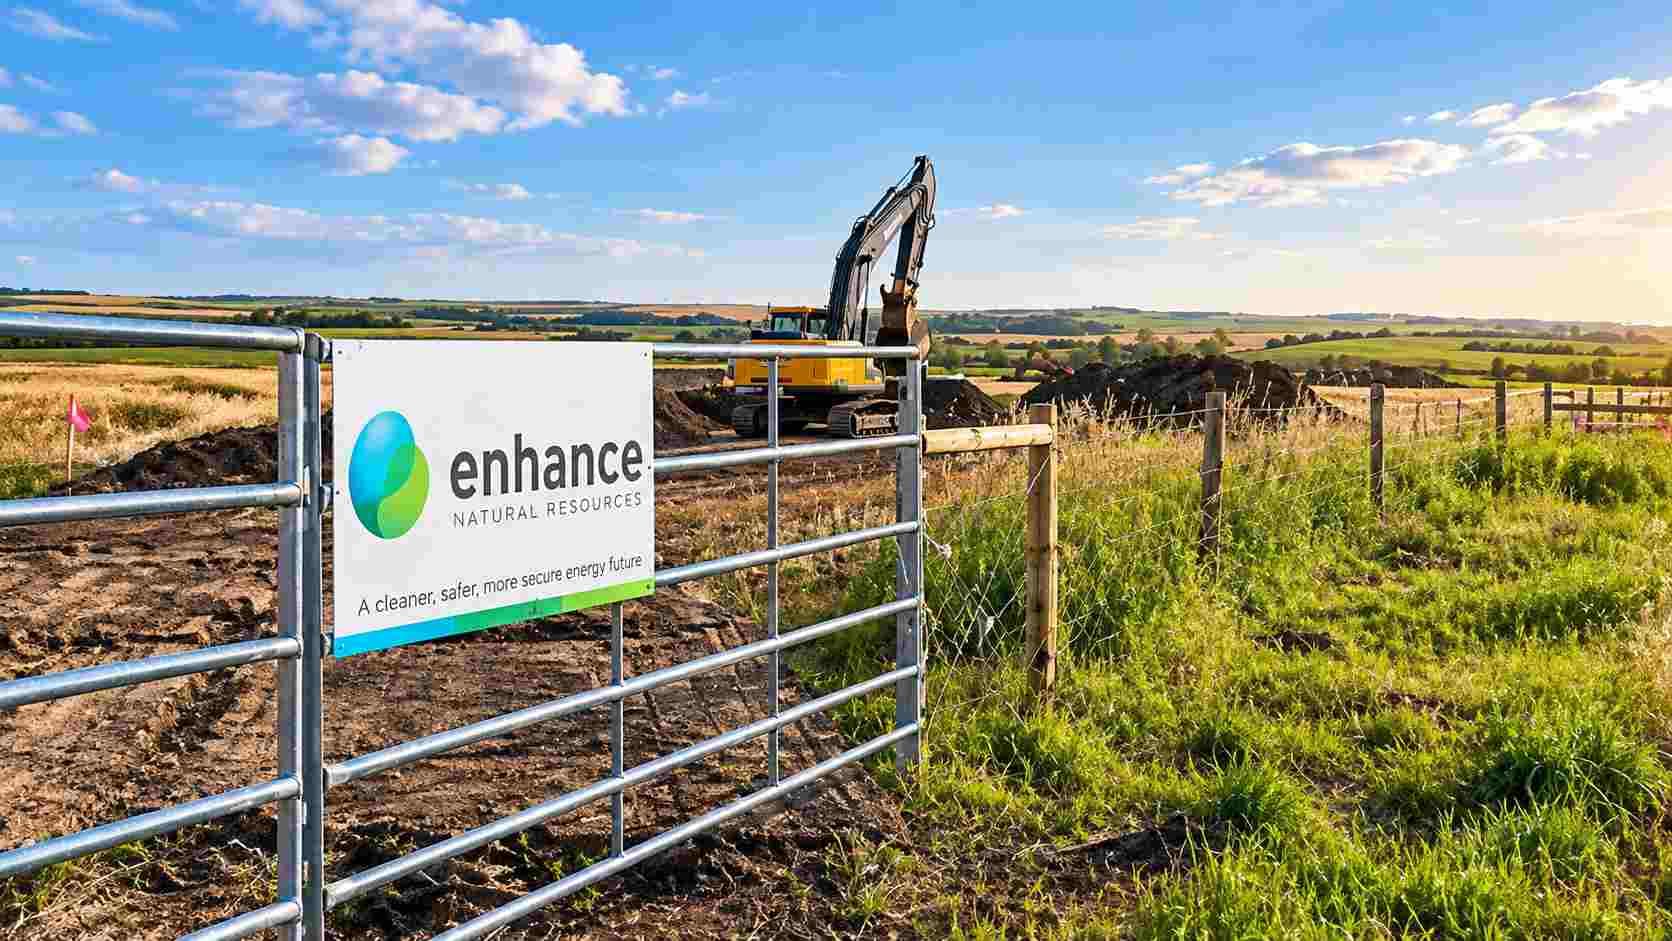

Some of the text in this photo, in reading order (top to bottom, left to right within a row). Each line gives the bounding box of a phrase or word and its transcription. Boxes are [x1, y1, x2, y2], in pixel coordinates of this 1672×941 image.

[449, 433, 644, 499] enhance
[453, 492, 642, 528] NATURAL RESOURCES
[357, 555, 643, 617] A cleaner, safer, more secure energy future
